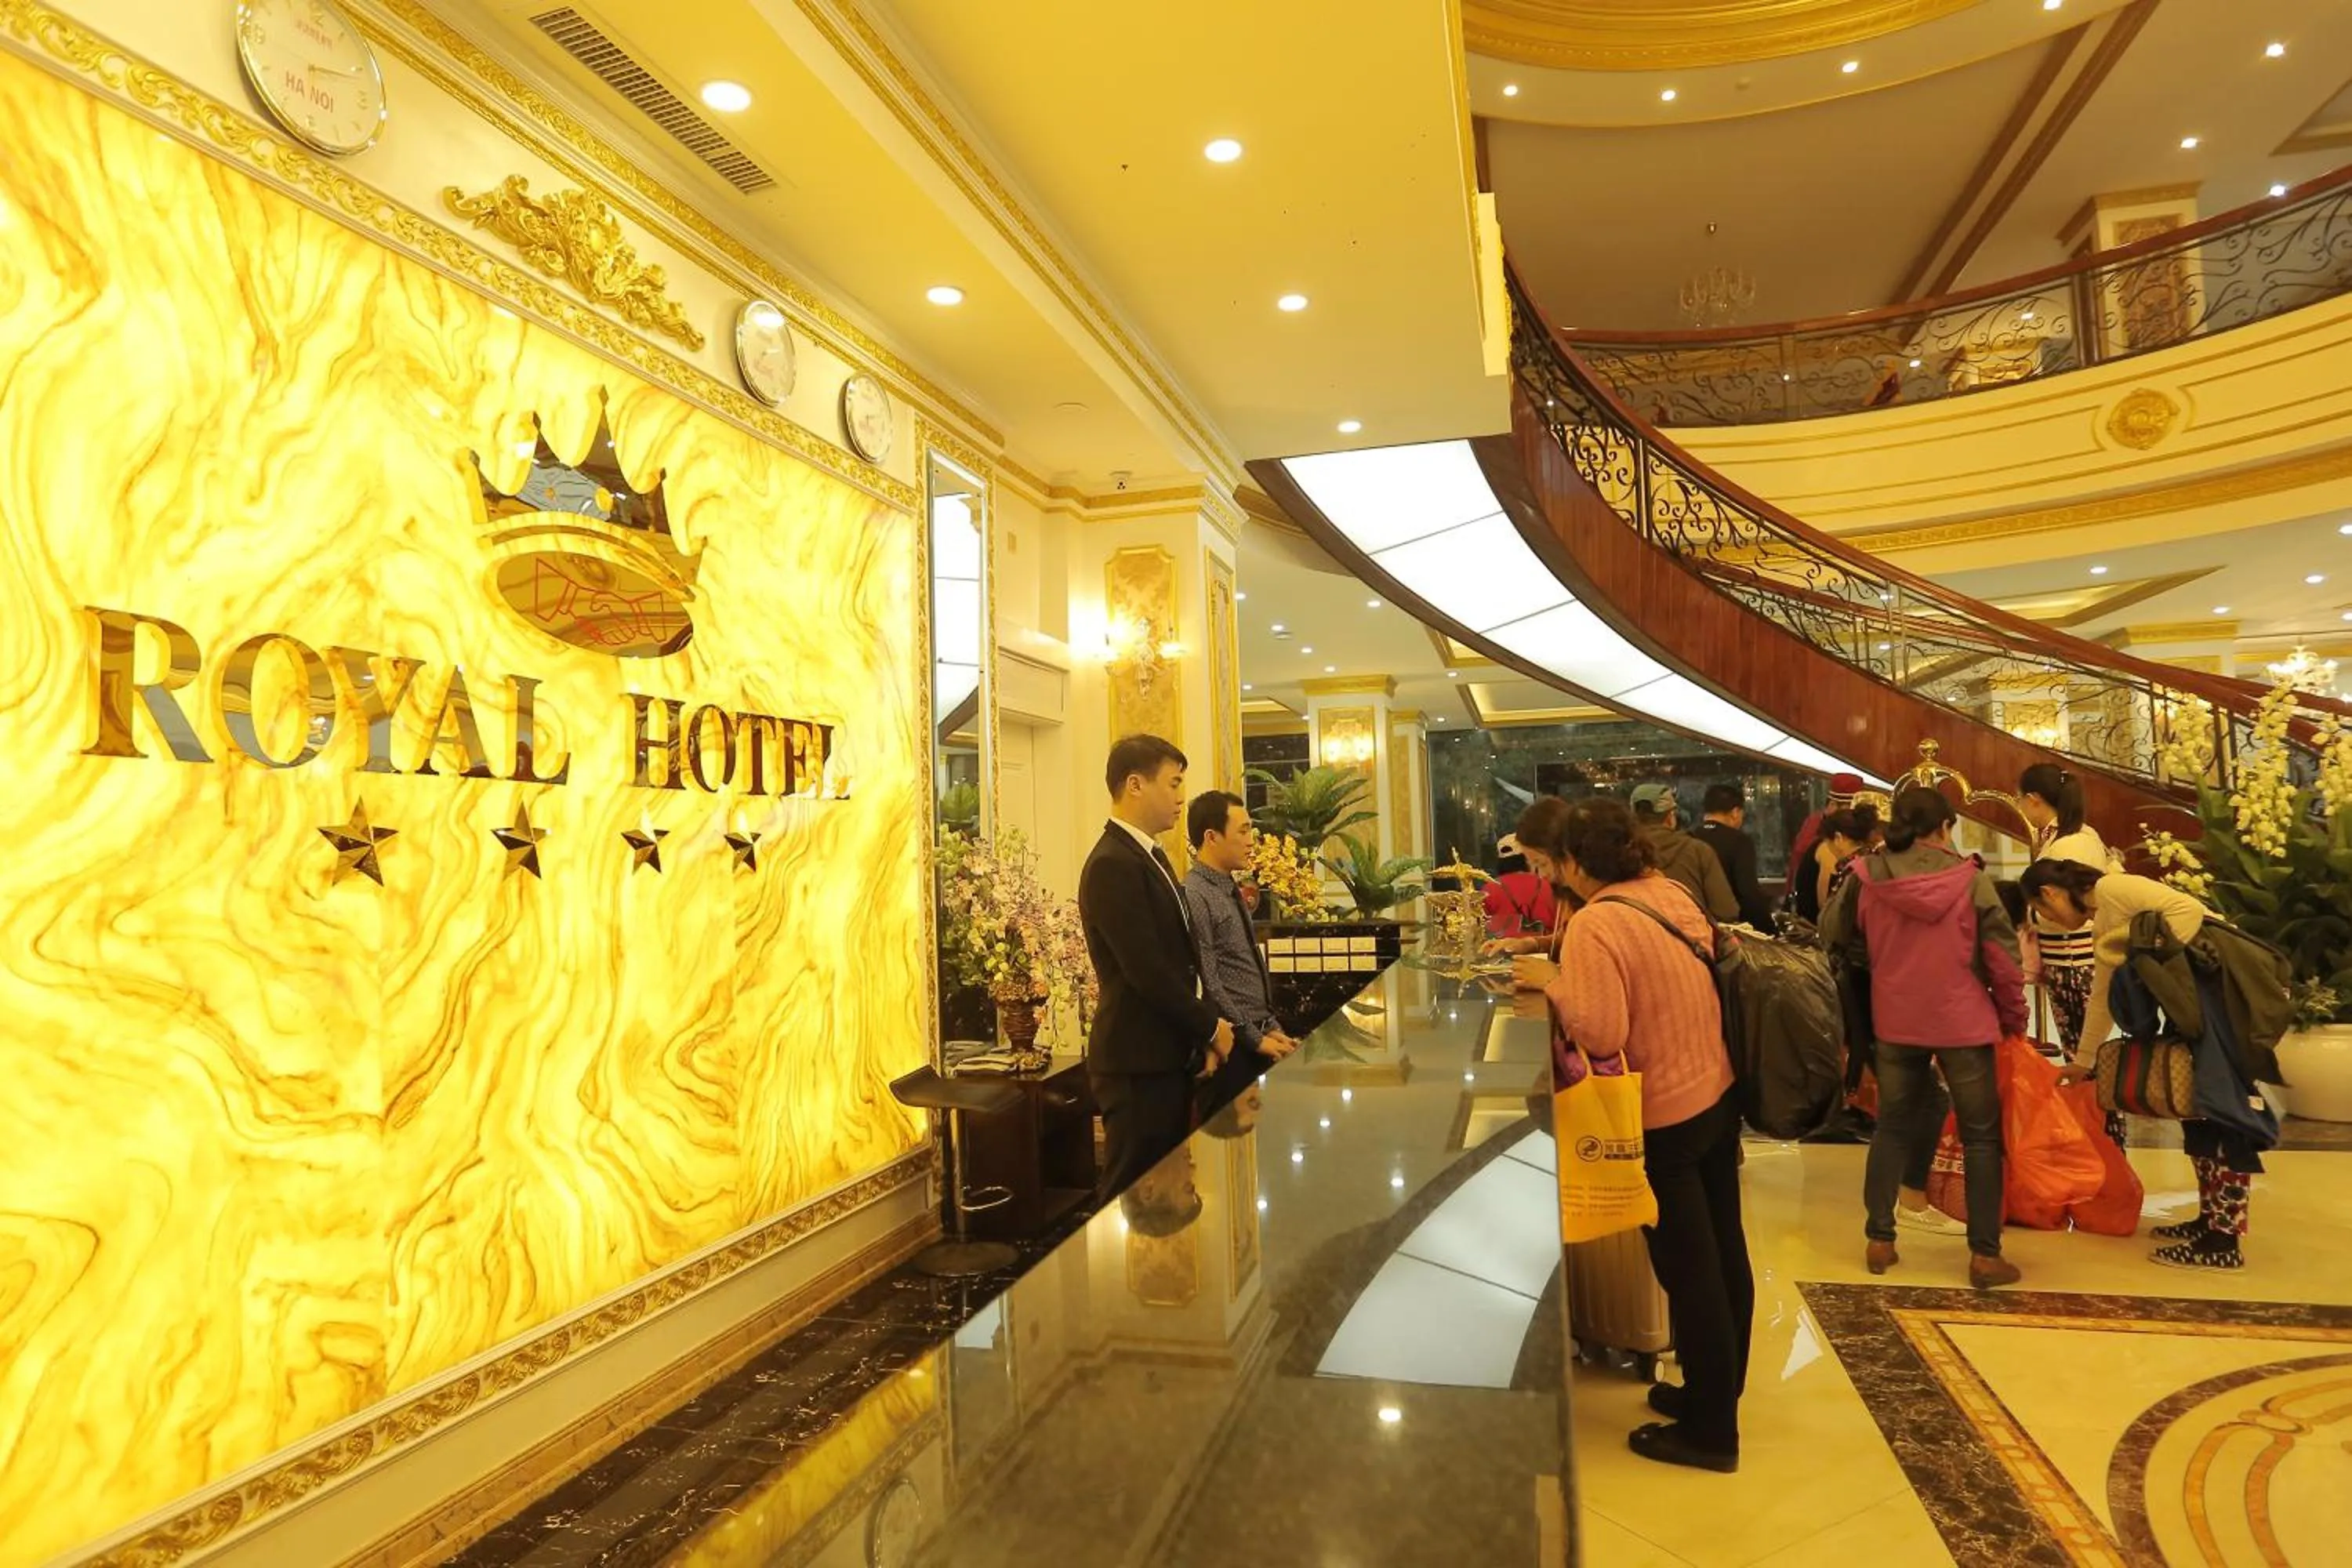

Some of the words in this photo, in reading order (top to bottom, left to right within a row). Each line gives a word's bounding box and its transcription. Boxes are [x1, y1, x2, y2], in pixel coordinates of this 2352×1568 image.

[285, 71, 305, 99] HA
[309, 85, 334, 114] NOI
[78, 604, 571, 785] ROYAL
[623, 692, 851, 800] HOTEL
